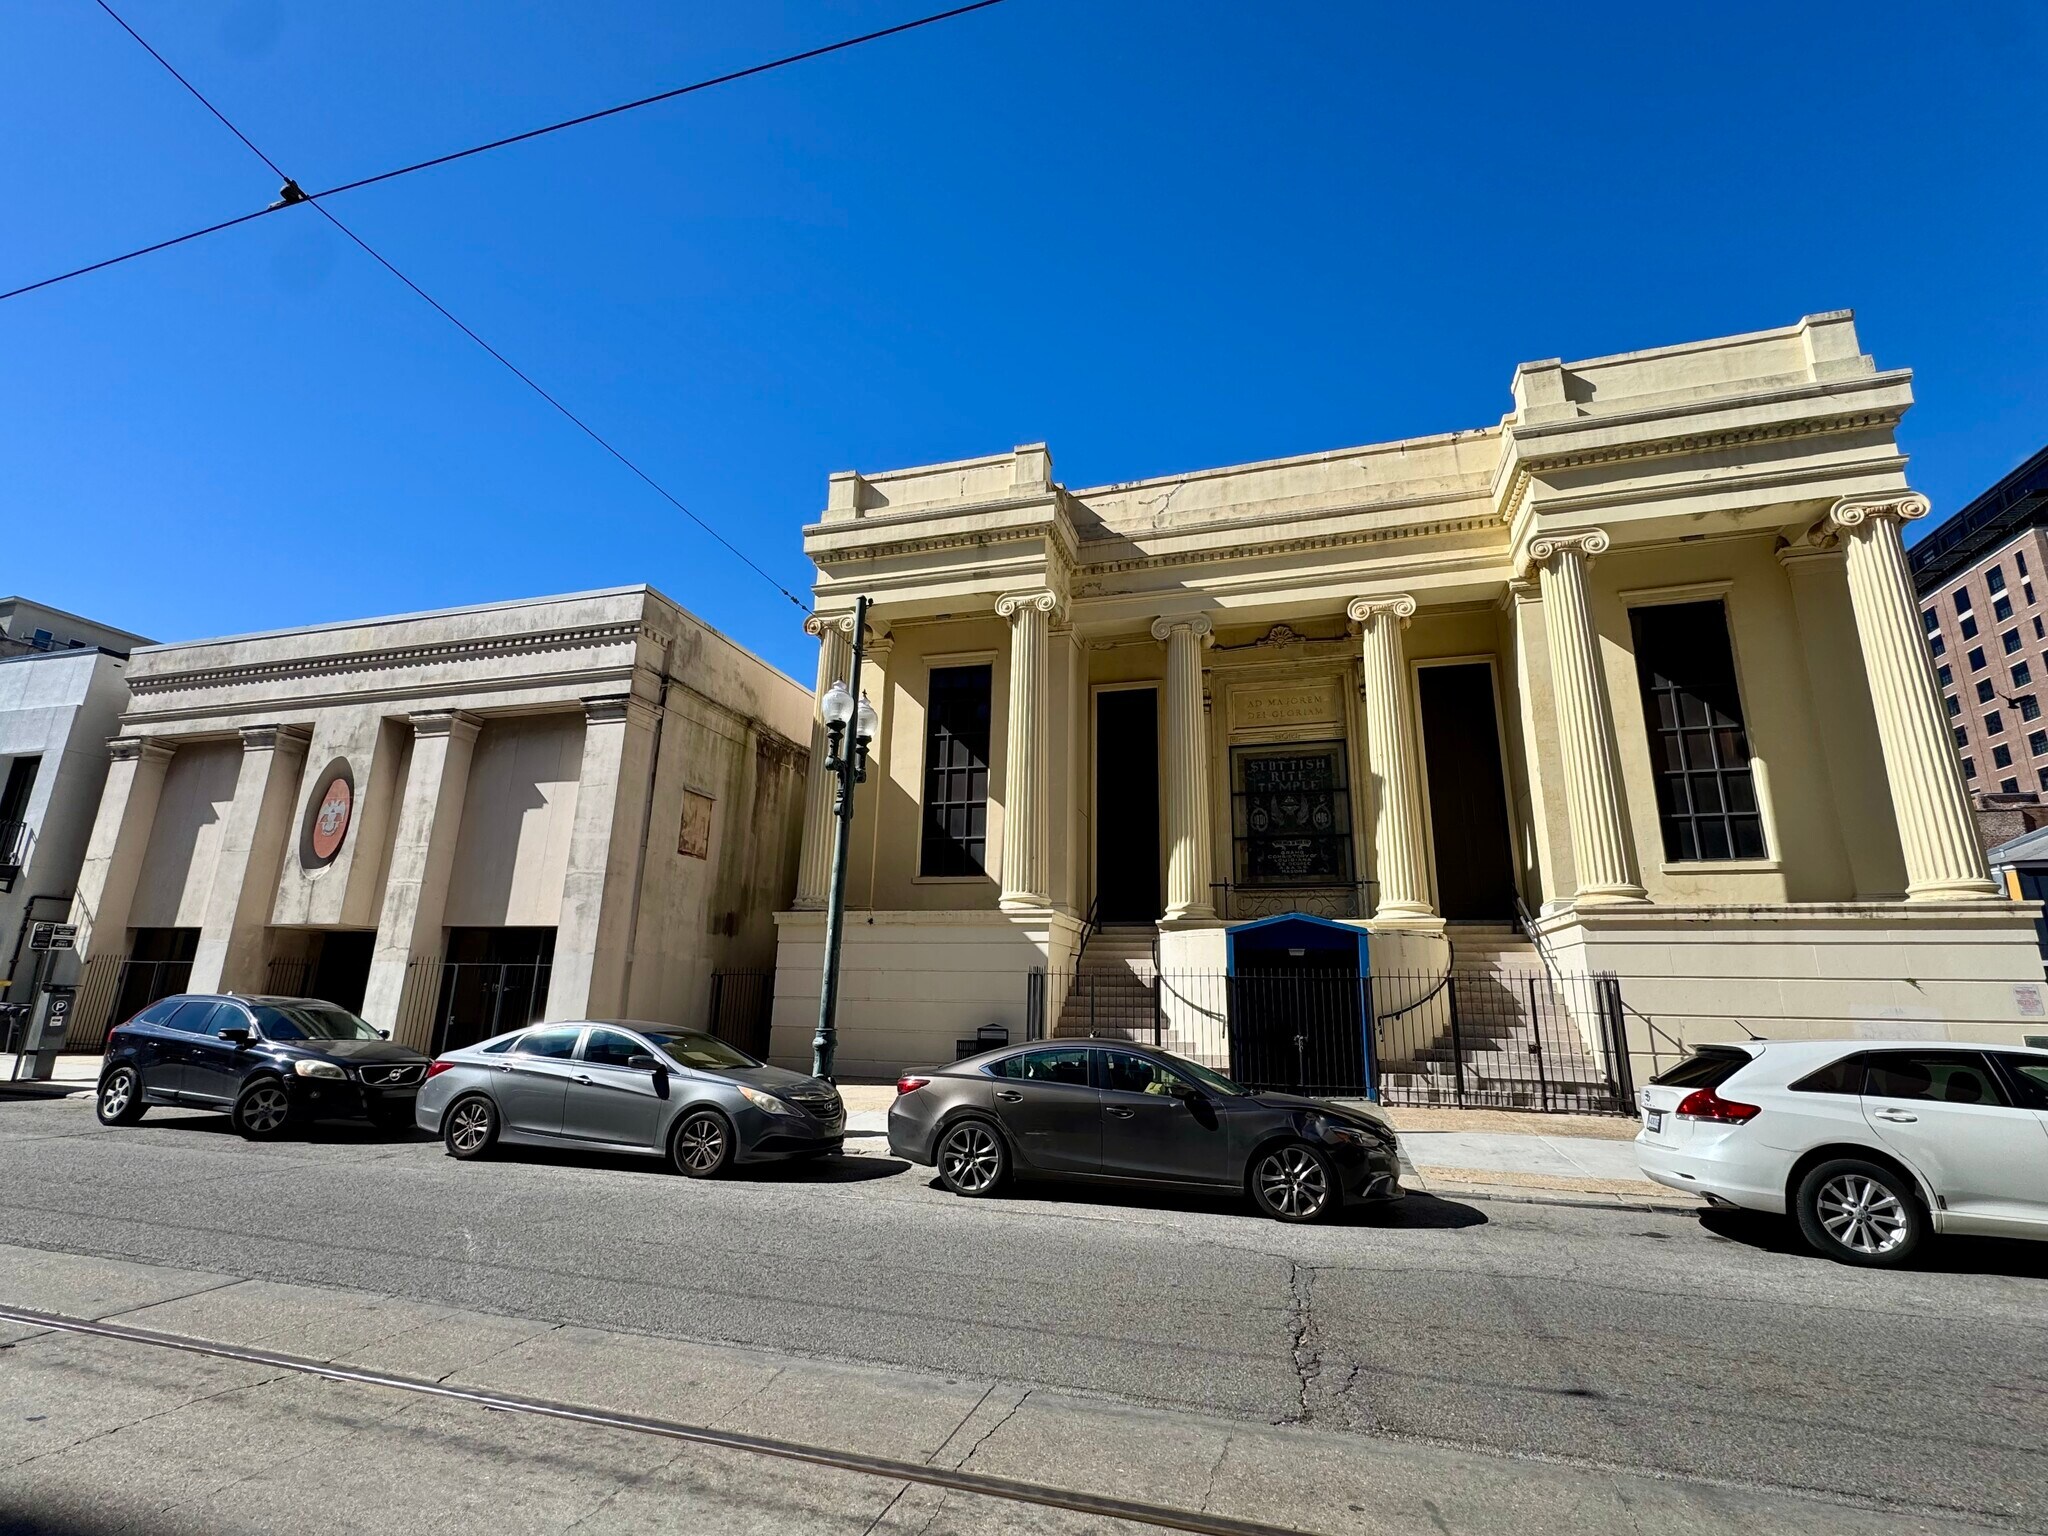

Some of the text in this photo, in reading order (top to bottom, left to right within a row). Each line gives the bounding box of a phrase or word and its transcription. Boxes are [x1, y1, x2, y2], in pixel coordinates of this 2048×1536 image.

[1247, 695, 1322, 709] AD MAJOREM
[1247, 707, 1324, 720] DEI GLORIAM
[1250, 758, 1326, 772] SCOTTISH
[1271, 770, 1306, 782] RITE
[1258, 780, 1319, 793] TEMPLE
[55, 1002, 65, 1011] P
